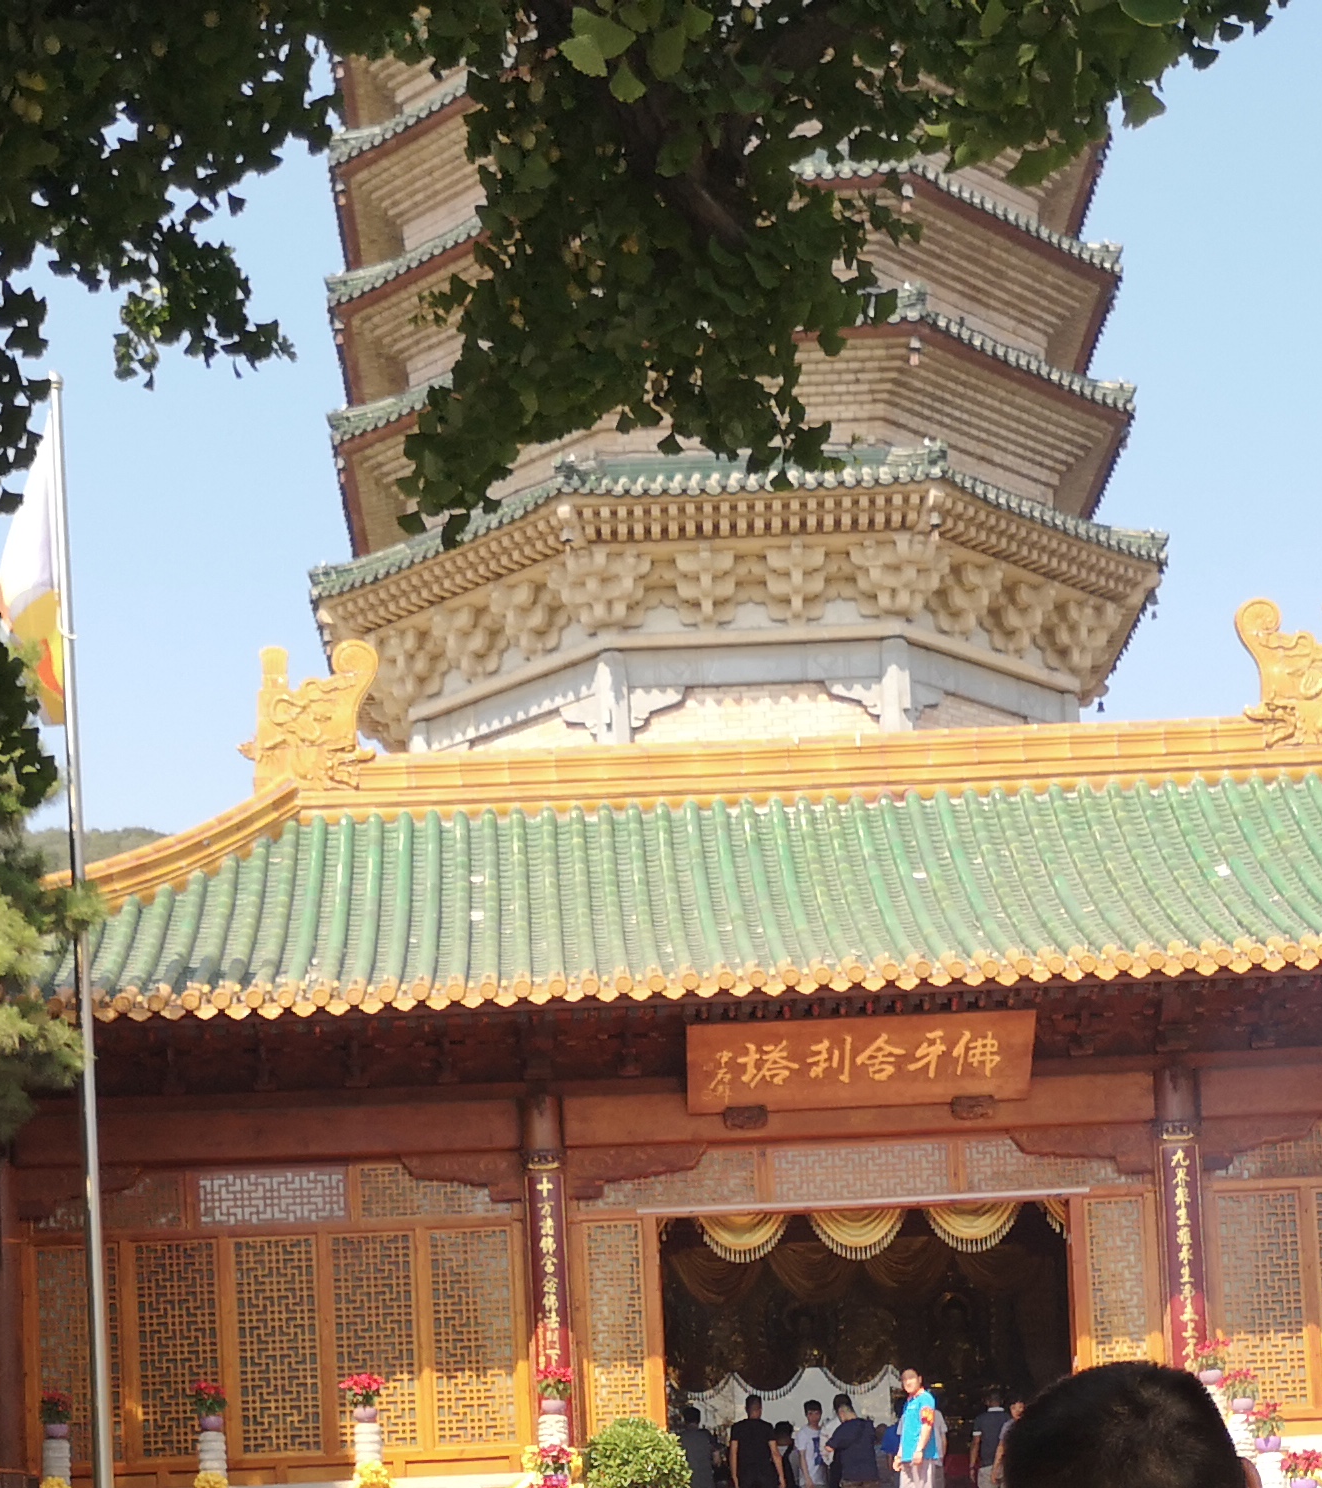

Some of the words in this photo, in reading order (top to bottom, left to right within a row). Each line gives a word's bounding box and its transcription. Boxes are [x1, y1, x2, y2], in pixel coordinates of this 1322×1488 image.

[737, 1030, 1001, 1088] 佛牙舍利塔
